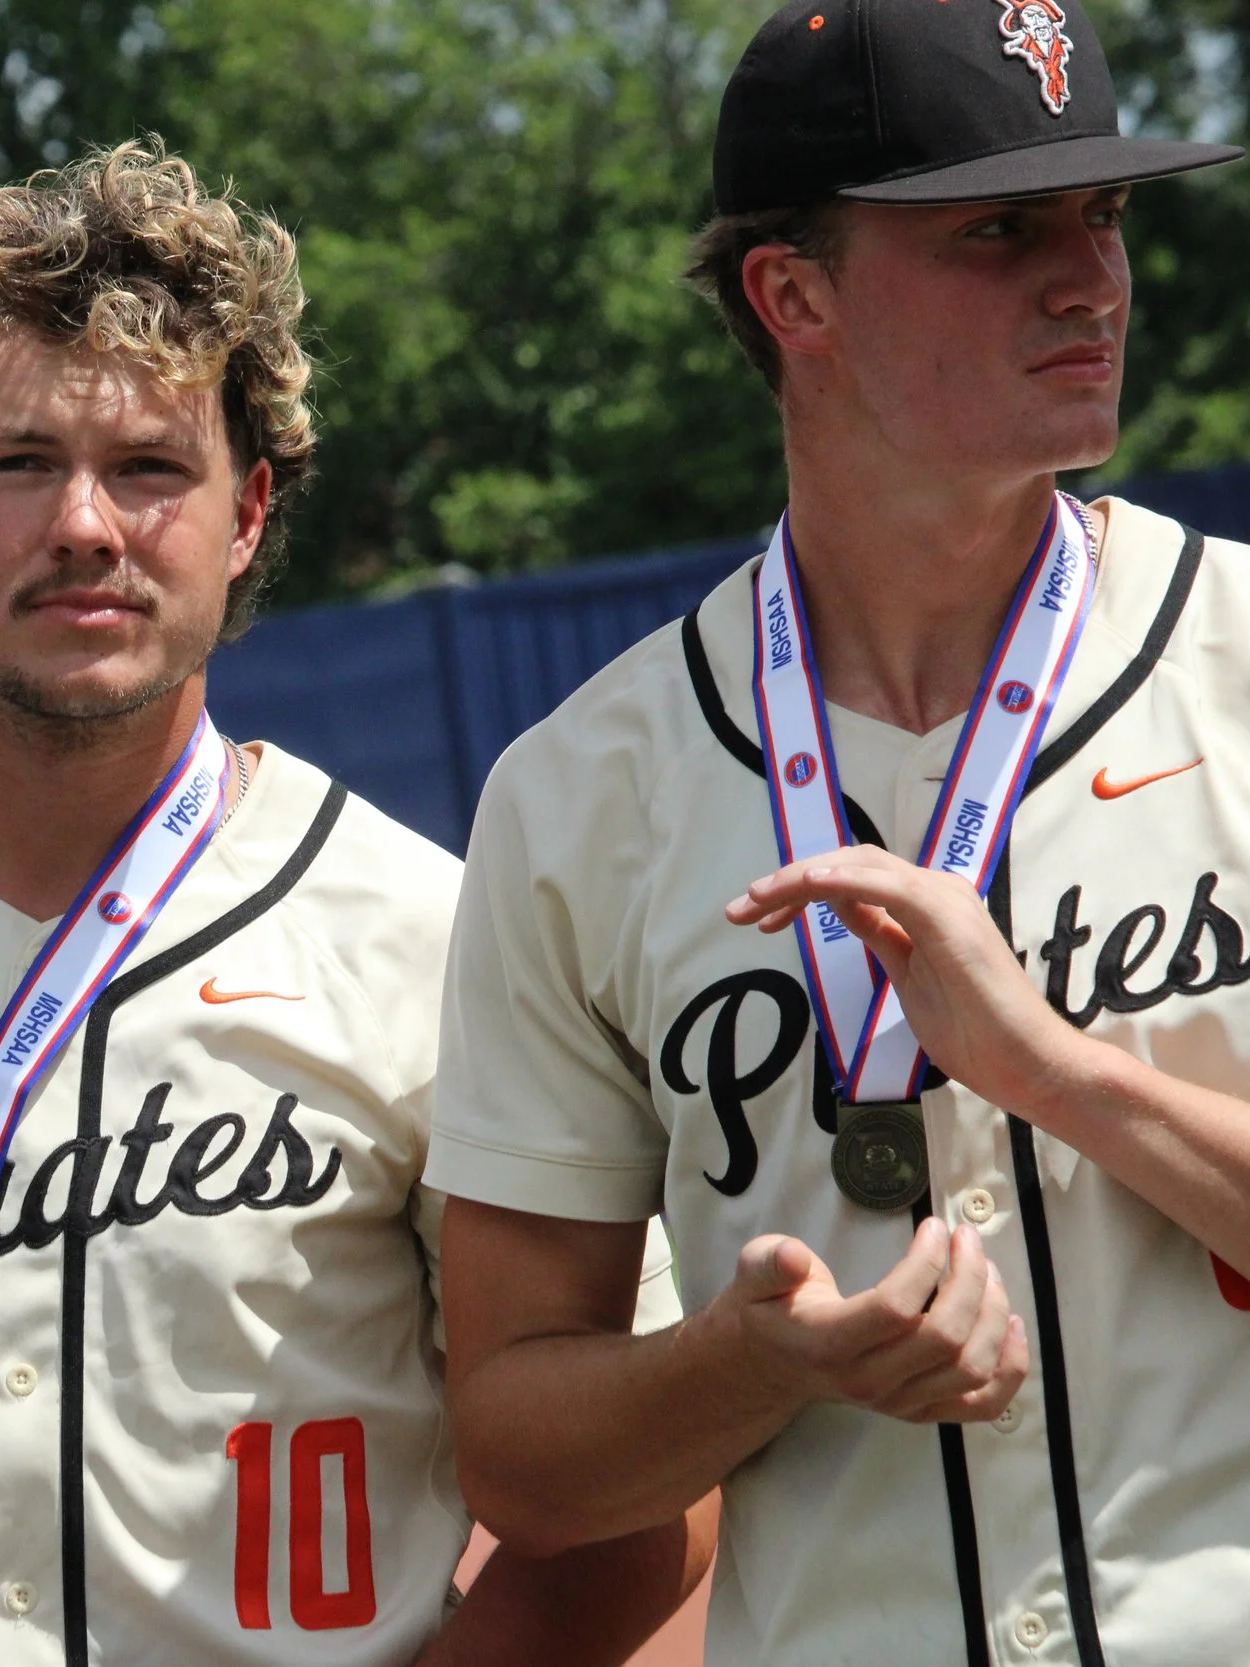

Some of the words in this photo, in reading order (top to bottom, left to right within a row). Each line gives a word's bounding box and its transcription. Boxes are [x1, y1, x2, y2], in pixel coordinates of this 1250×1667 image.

[767, 588, 792, 670] MSHSAA
[162, 764, 214, 837] MSHSAA
[1, 991, 63, 1066] MSHSAA
[226, 1416, 377, 1631] 10
